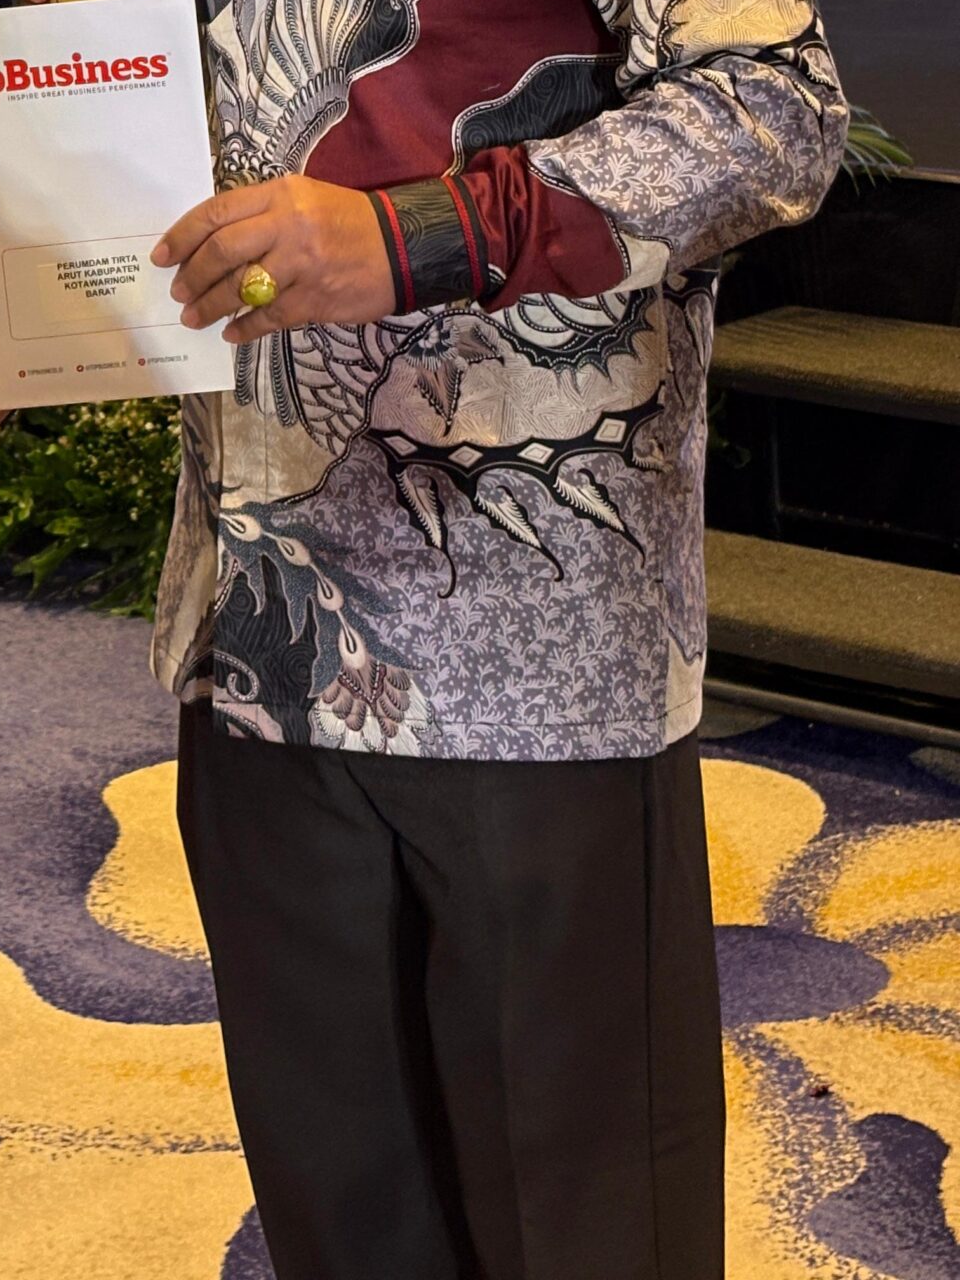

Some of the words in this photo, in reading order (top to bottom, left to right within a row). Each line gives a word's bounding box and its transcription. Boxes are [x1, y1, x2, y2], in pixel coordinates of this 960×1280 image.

[8, 93, 39, 102] INSPIRE
[42, 90, 66, 98] GREAT
[68, 88, 106, 96] BUSINESS
[109, 80, 166, 92] PERFORMANCE
[57, 258, 110, 270] PERUMDAM
[111, 254, 138, 264] TIRTA
[58, 270, 82, 280] ARUT
[84, 264, 140, 277] KABUPATEN
[64, 275, 135, 290] KOTAWARINGIN
[86, 287, 116, 298] BARAT
